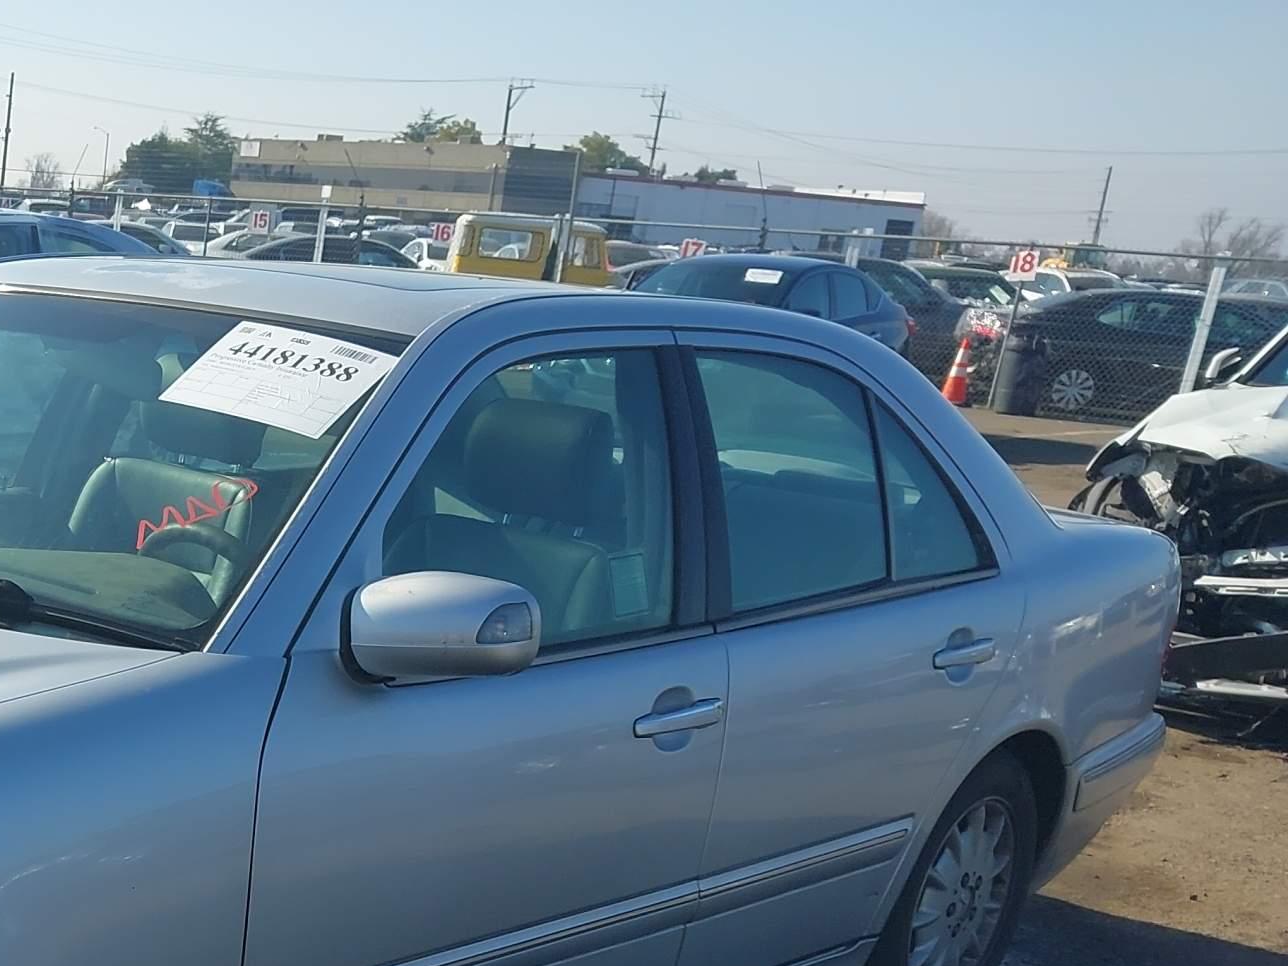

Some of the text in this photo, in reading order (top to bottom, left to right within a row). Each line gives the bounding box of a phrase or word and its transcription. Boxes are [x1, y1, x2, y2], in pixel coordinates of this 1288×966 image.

[253, 213, 268, 229] 15
[434, 224, 451, 241] 16
[683, 240, 704, 257] 17
[1013, 252, 1036, 273] 18
[229, 341, 360, 382] 44181388
